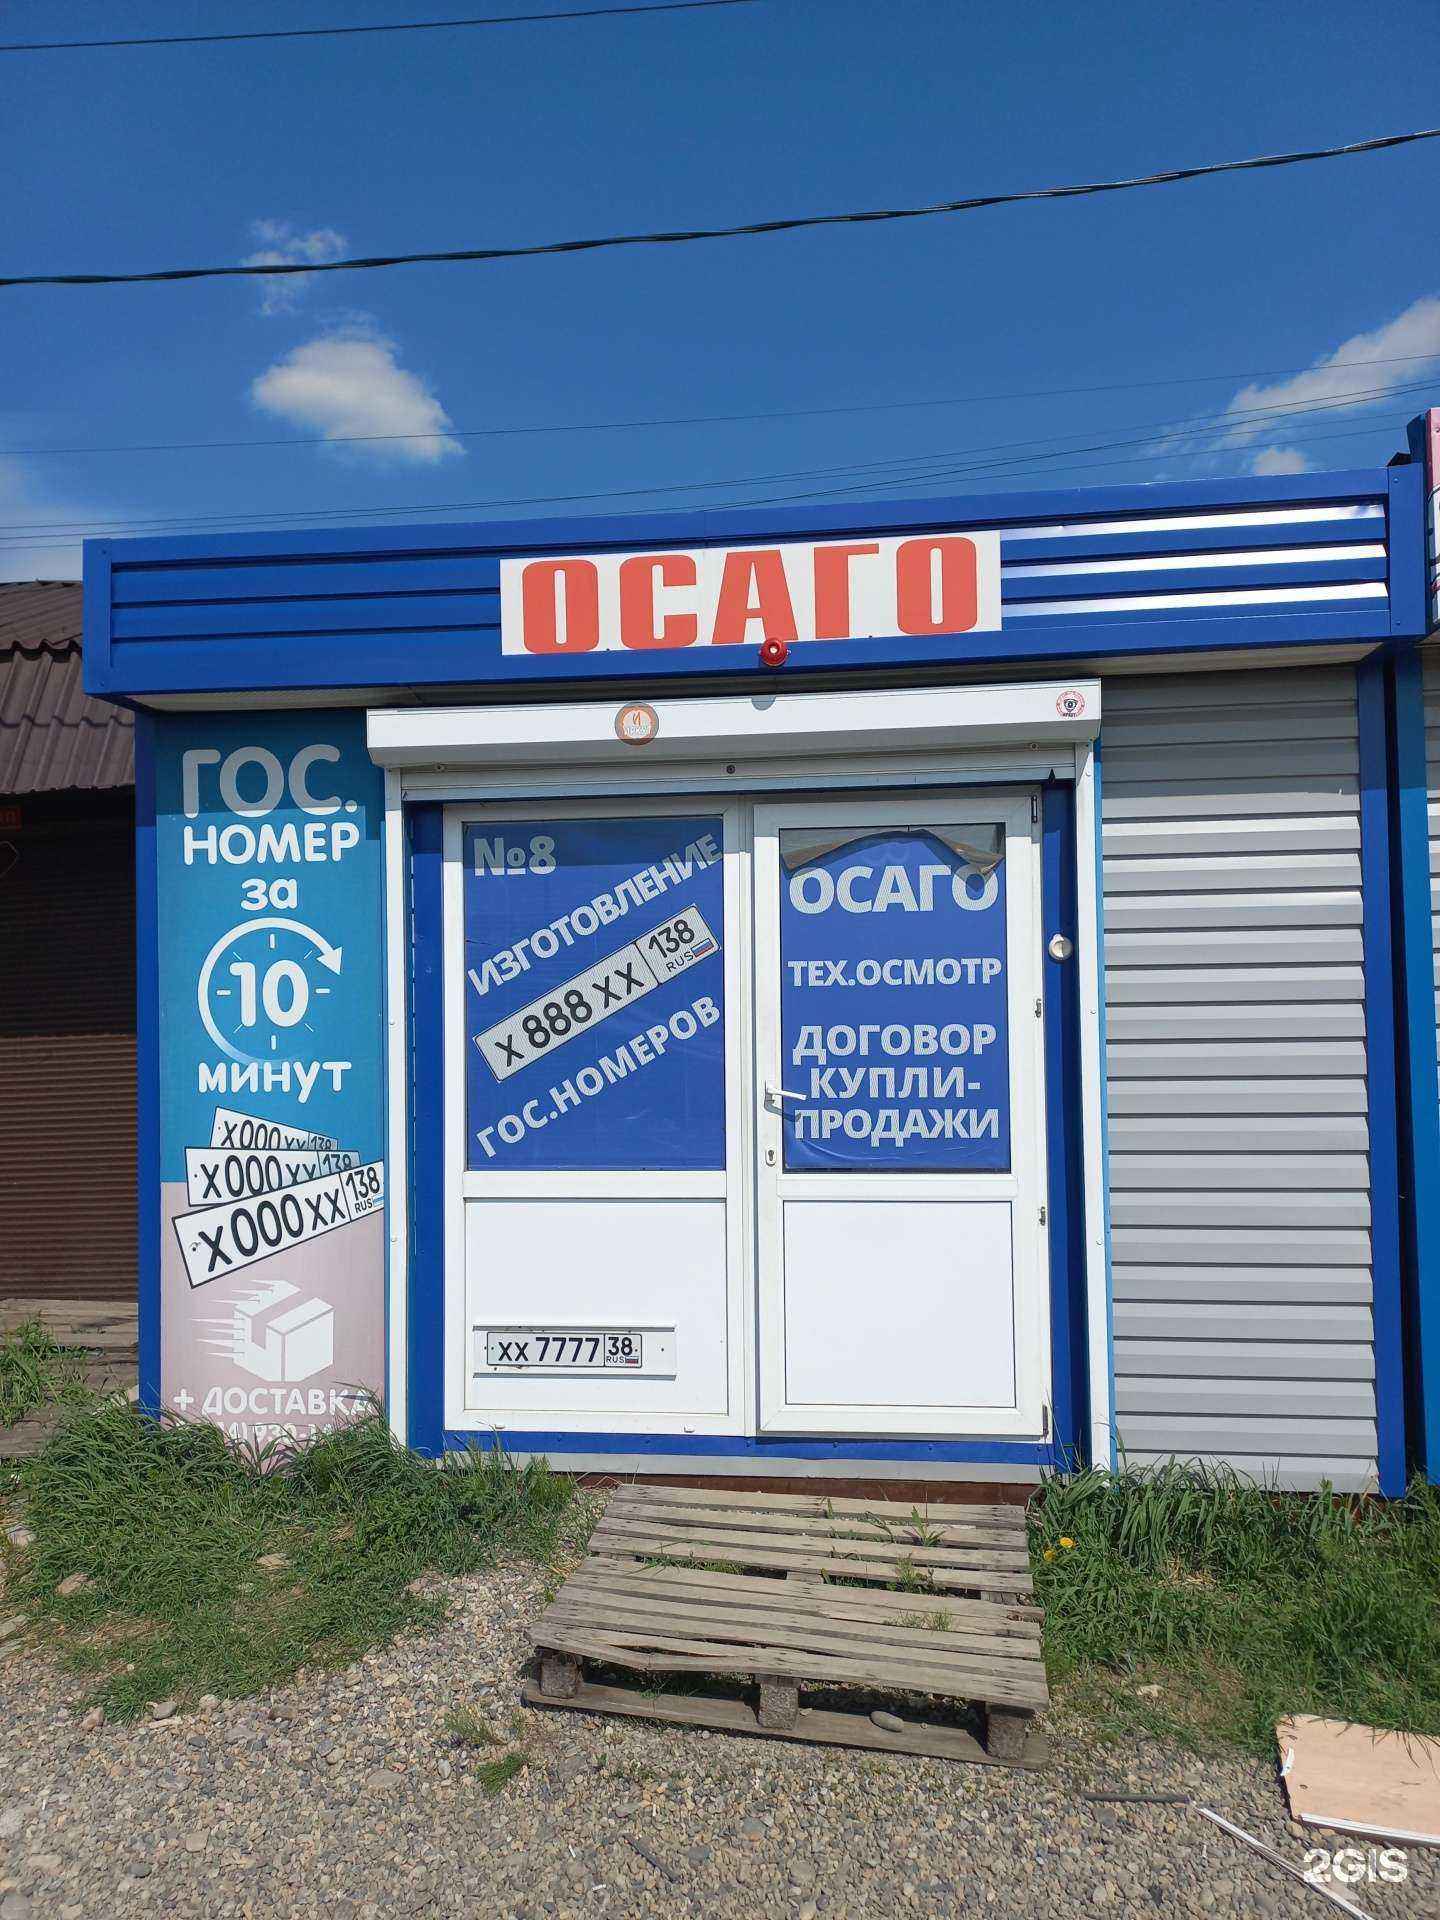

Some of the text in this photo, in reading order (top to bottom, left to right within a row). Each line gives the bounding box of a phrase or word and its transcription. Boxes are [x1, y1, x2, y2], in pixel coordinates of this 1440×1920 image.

[522, 537, 977, 654] ОСАГО
[182, 744, 358, 819] ГОС.
[184, 822, 360, 865] НОМЕР
[473, 836, 557, 876] №8
[240, 878, 298, 910] за
[789, 865, 999, 914] ОСАГО
[468, 833, 722, 996] ИЗГОТОВЛЕНИЕ
[648, 919, 696, 958] 138
[665, 950, 695, 973] RUS
[788, 958, 1002, 987] ТЕХ.ОСМОТР
[229, 959, 309, 1027] 10
[792, 1023, 997, 1066] ДОГОВОР
[476, 996, 721, 1158] ГОС.НОМЕРОВ
[810, 1067, 981, 1099] КУПЛИ-
[794, 1108, 1000, 1148] ПРОДАЖИ
[345, 1166, 381, 1202] 138
[354, 1198, 374, 1214] RUS
[535, 1336, 600, 1363] 7777
[608, 1336, 634, 1356] 38
[606, 1355, 625, 1364] RUS
[201, 1386, 374, 1416] ДОСТАВКА
